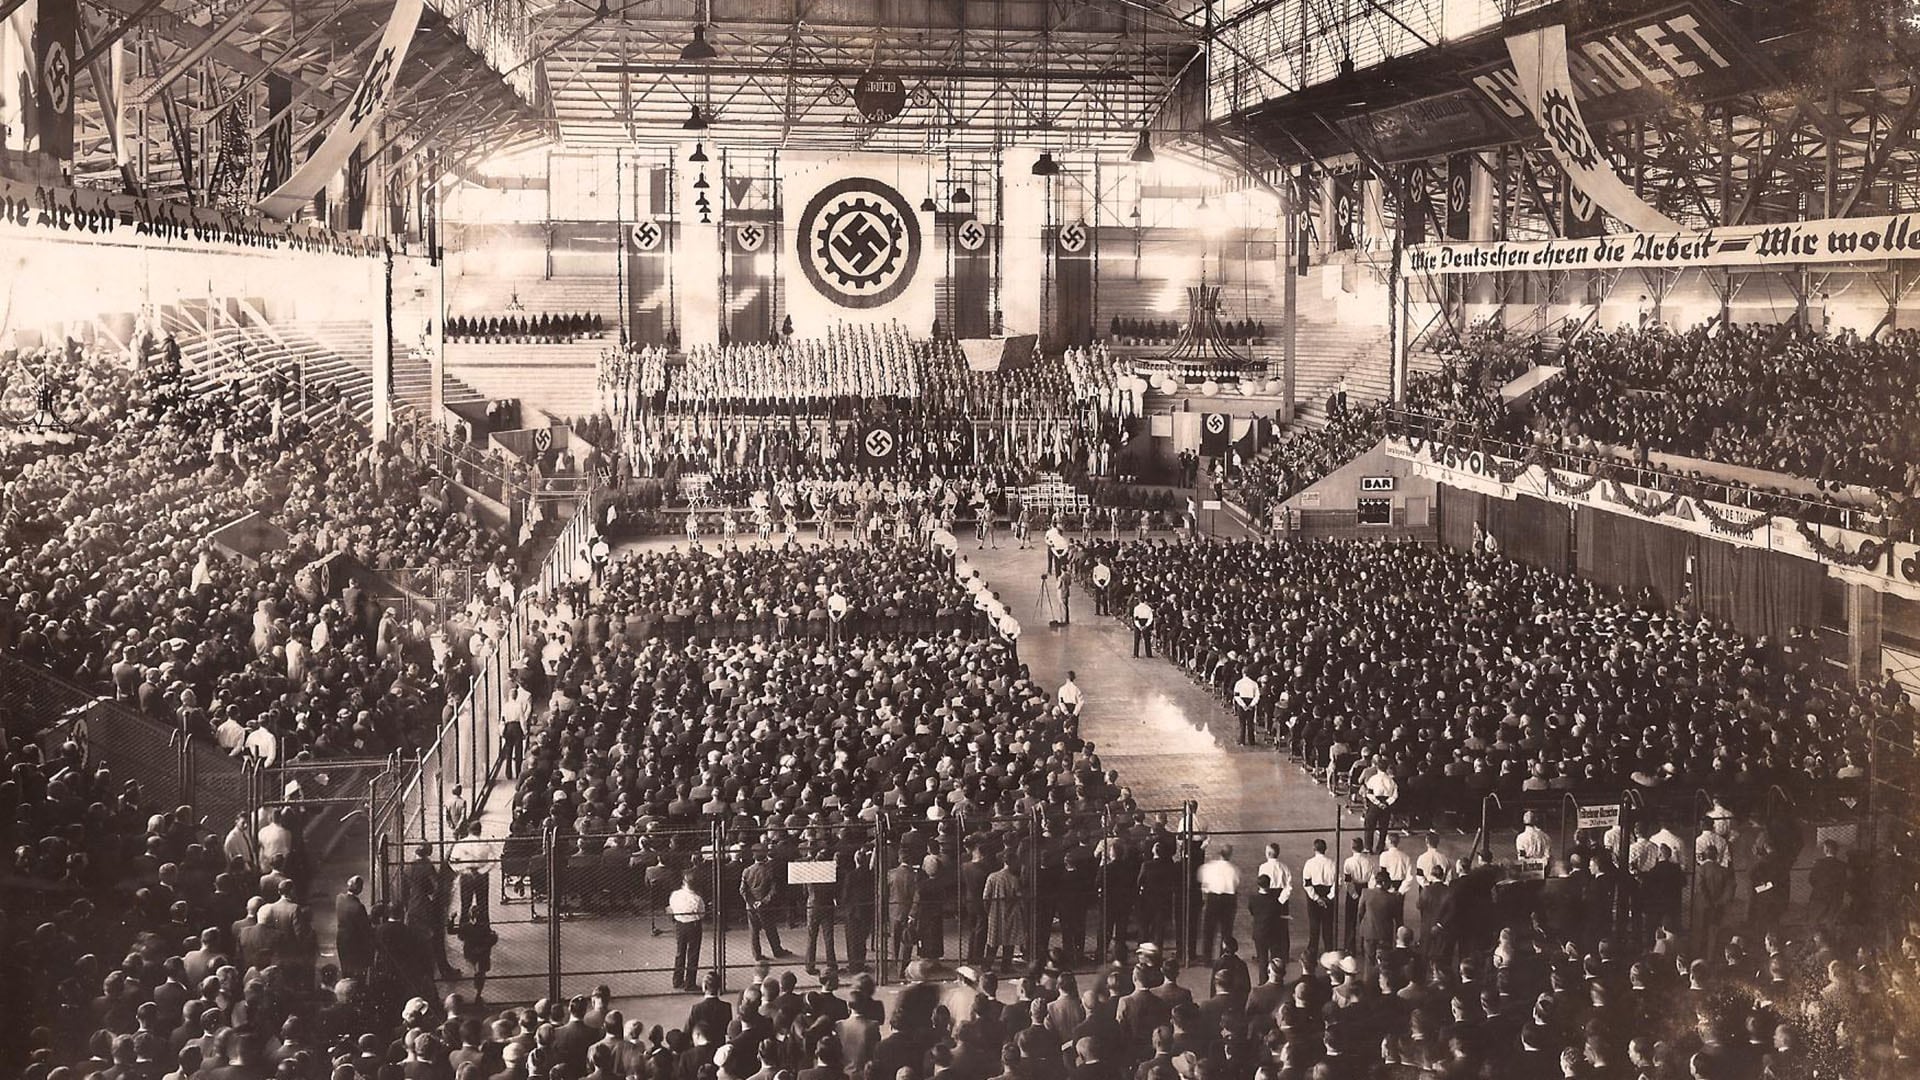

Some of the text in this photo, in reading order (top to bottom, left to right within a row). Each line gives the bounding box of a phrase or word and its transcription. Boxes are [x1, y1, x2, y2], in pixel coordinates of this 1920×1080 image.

[1472, 13, 1730, 119] CHROLET
[0, 183, 30, 227] ie
[36, 185, 116, 234] Arbeit
[1411, 250, 1437, 272] Wir
[1440, 242, 1530, 269] Deutschen
[1533, 240, 1587, 269] ehren
[1593, 235, 1625, 262] die
[1631, 228, 1719, 261] Arbeit
[1756, 225, 1819, 257] Wir
[1364, 479, 1391, 489] BAR
